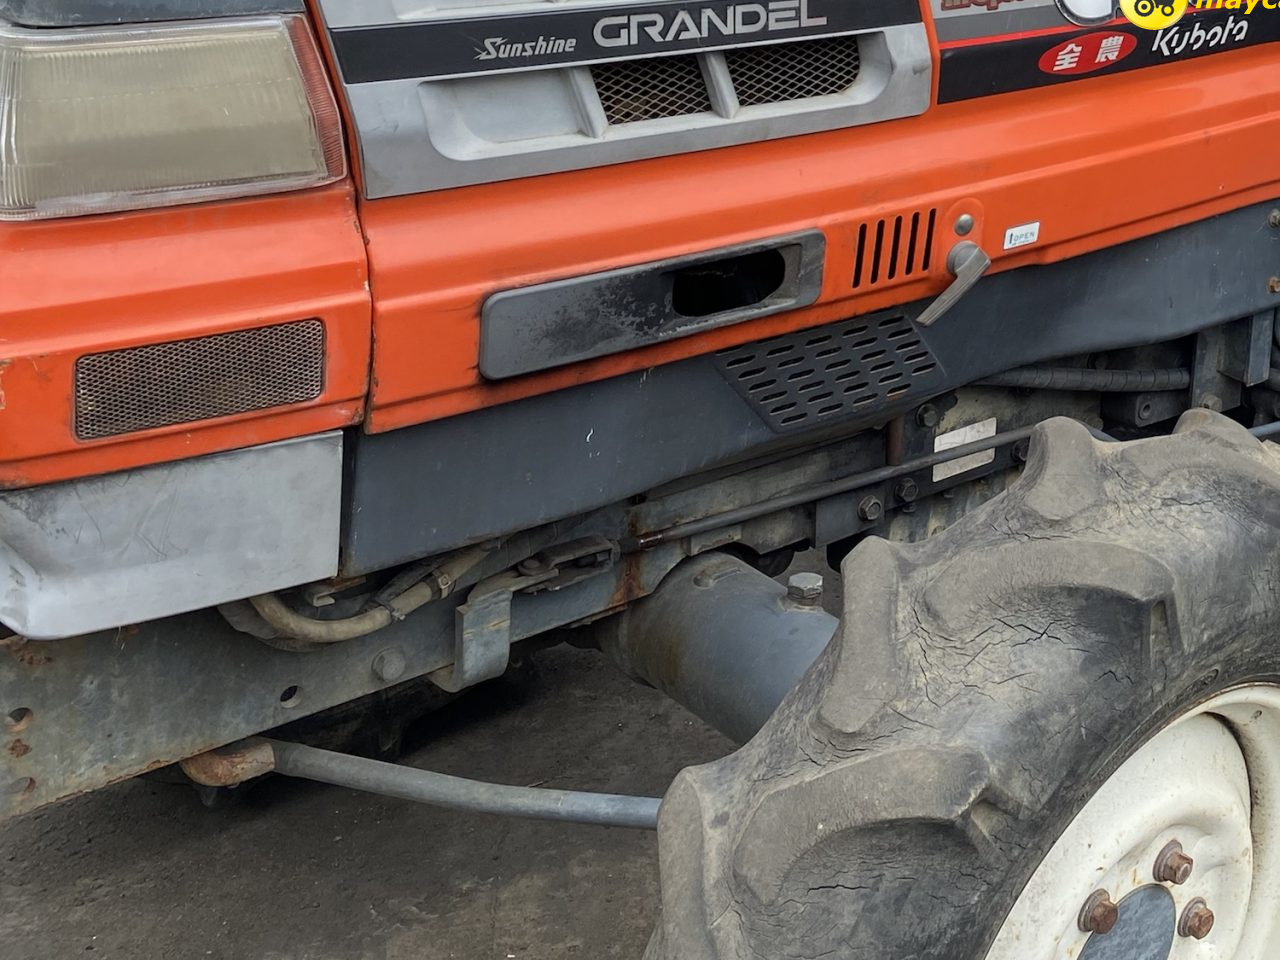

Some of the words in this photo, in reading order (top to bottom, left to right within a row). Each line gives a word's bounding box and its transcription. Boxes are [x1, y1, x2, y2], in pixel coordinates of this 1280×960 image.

[474, 35, 576, 61] Sunshine
[593, 0, 827, 48] GRANDEL
[1152, 15, 1248, 57] Kubota
